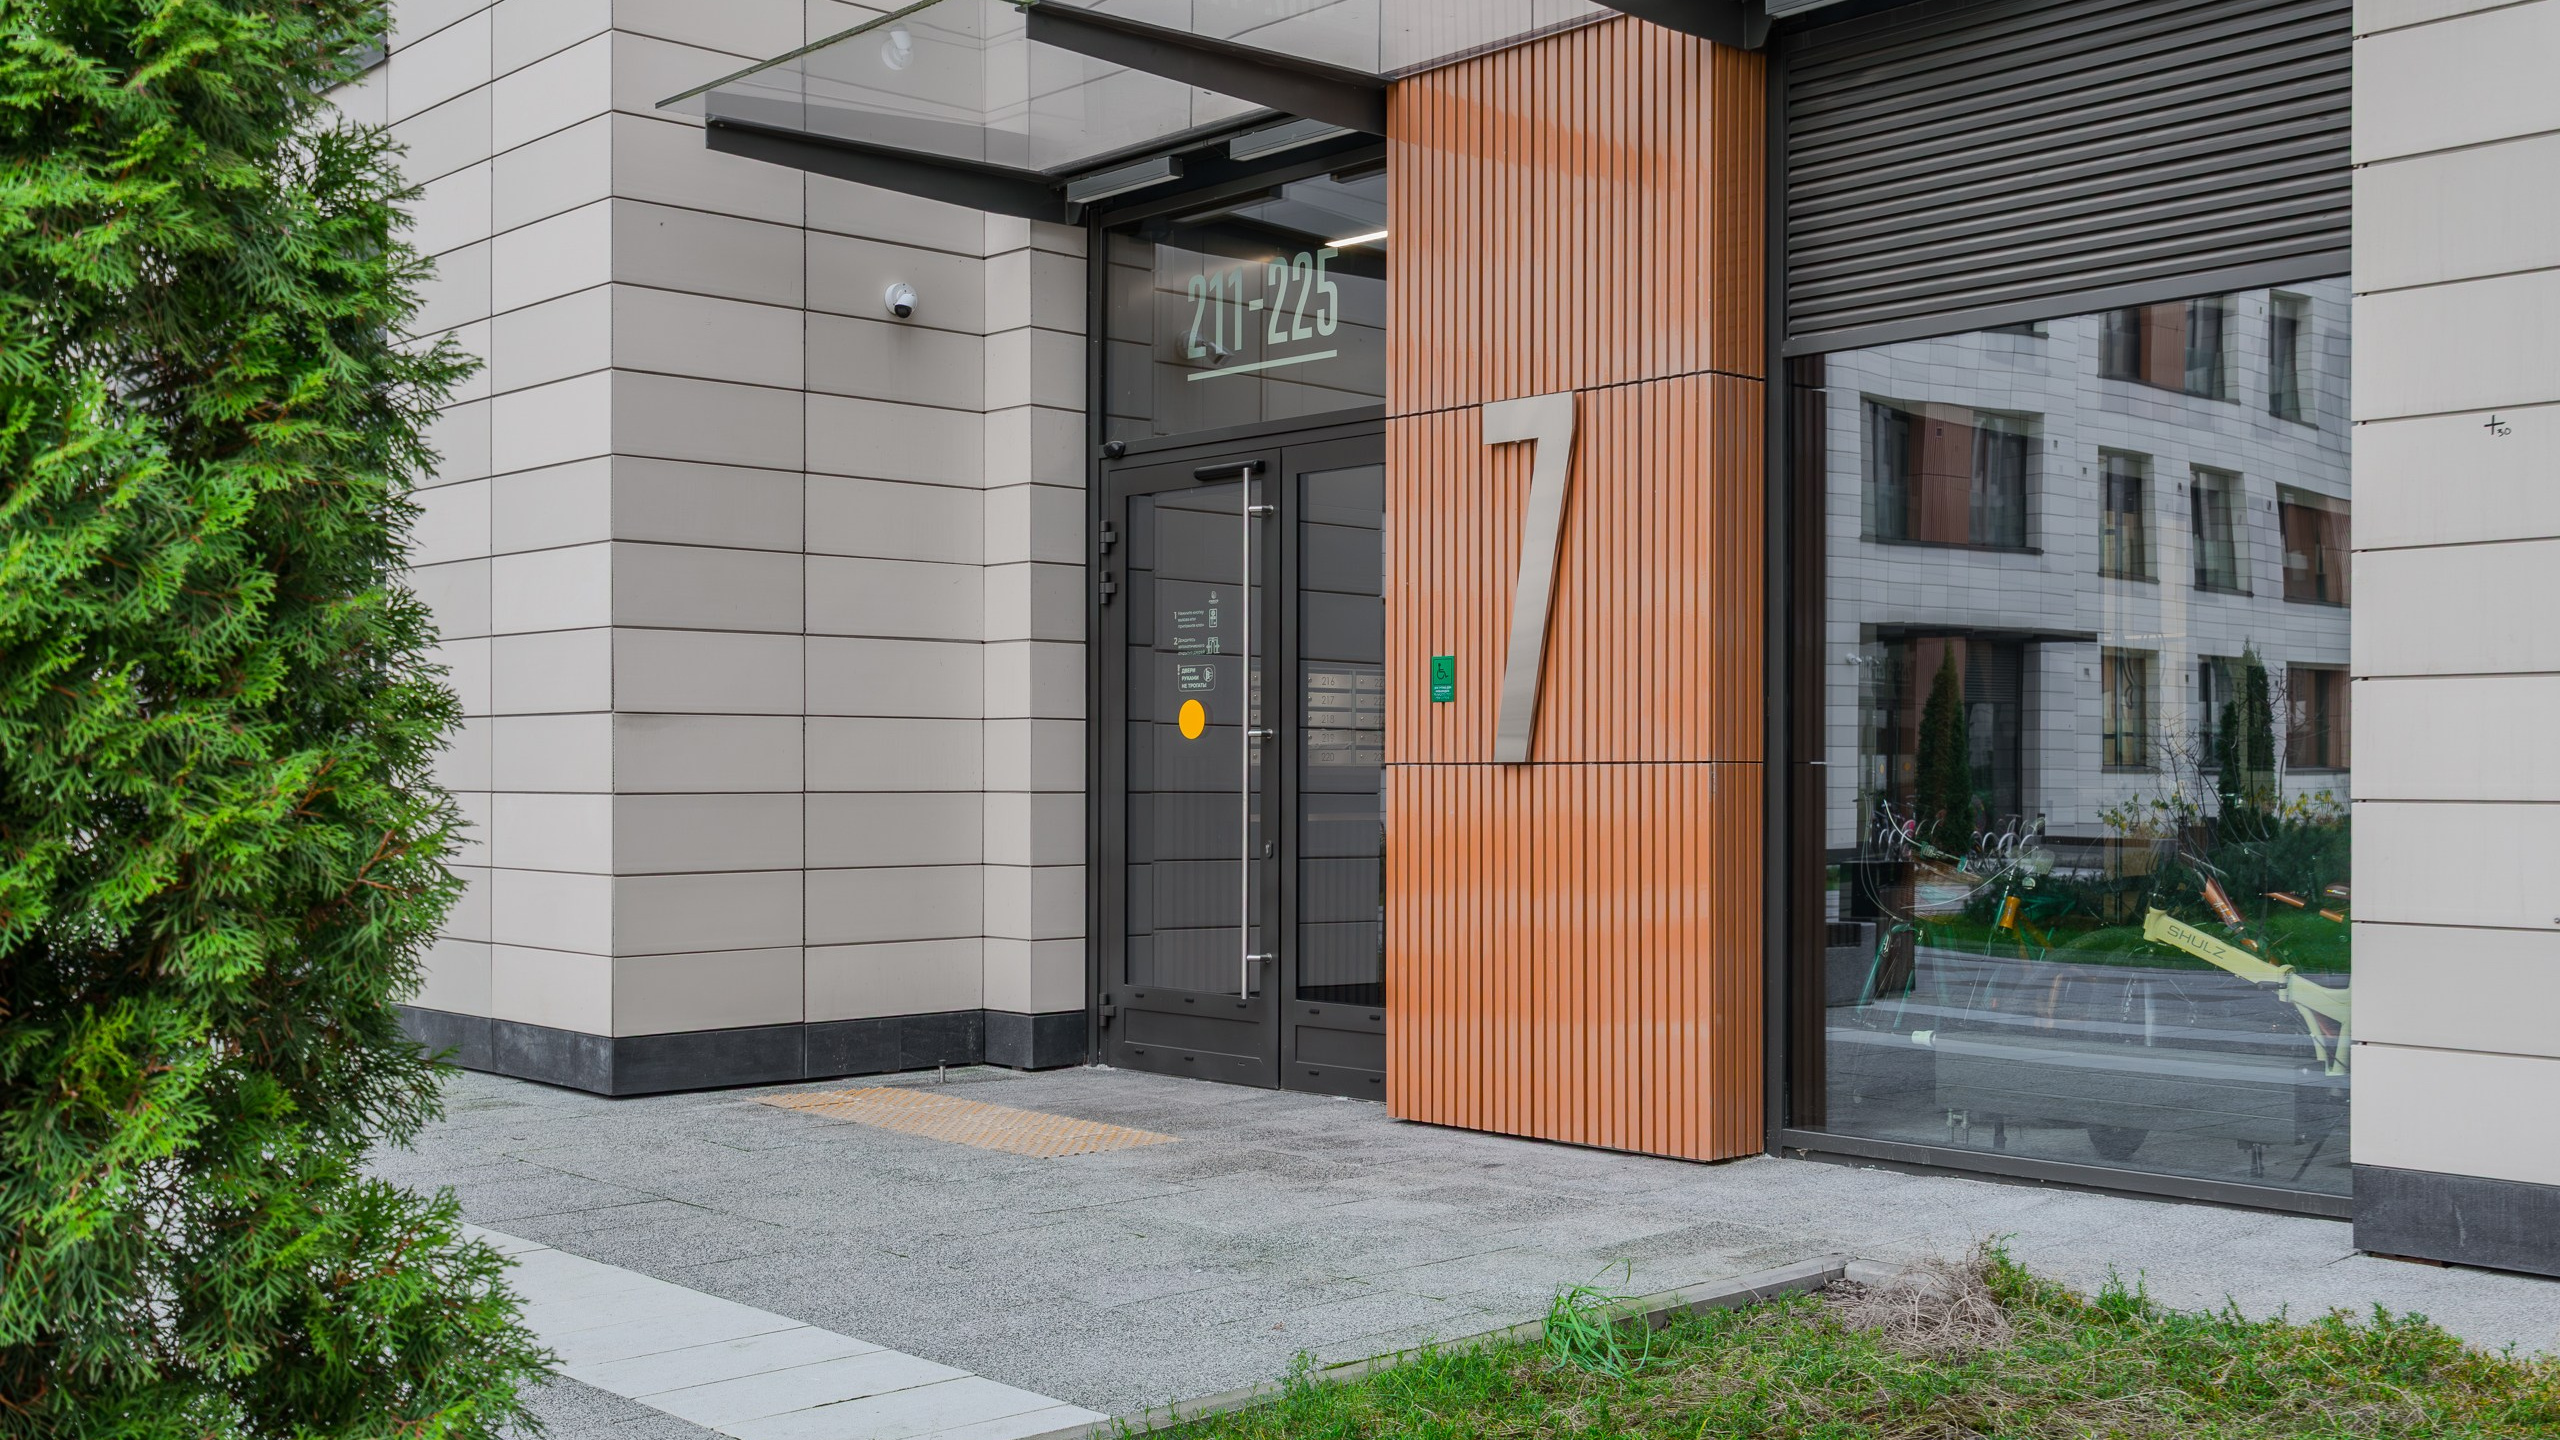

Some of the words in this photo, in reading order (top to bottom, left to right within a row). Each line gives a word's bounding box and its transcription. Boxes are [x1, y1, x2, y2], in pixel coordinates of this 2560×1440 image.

[1187, 247, 1338, 359] 211-225
[1483, 390, 1576, 762] 7
[1321, 676, 1335, 686] 216
[1321, 695, 1335, 705] 217
[1321, 714, 1335, 724] 218
[1321, 752, 1335, 762] 220
[2167, 925, 2227, 960] SHULZ
